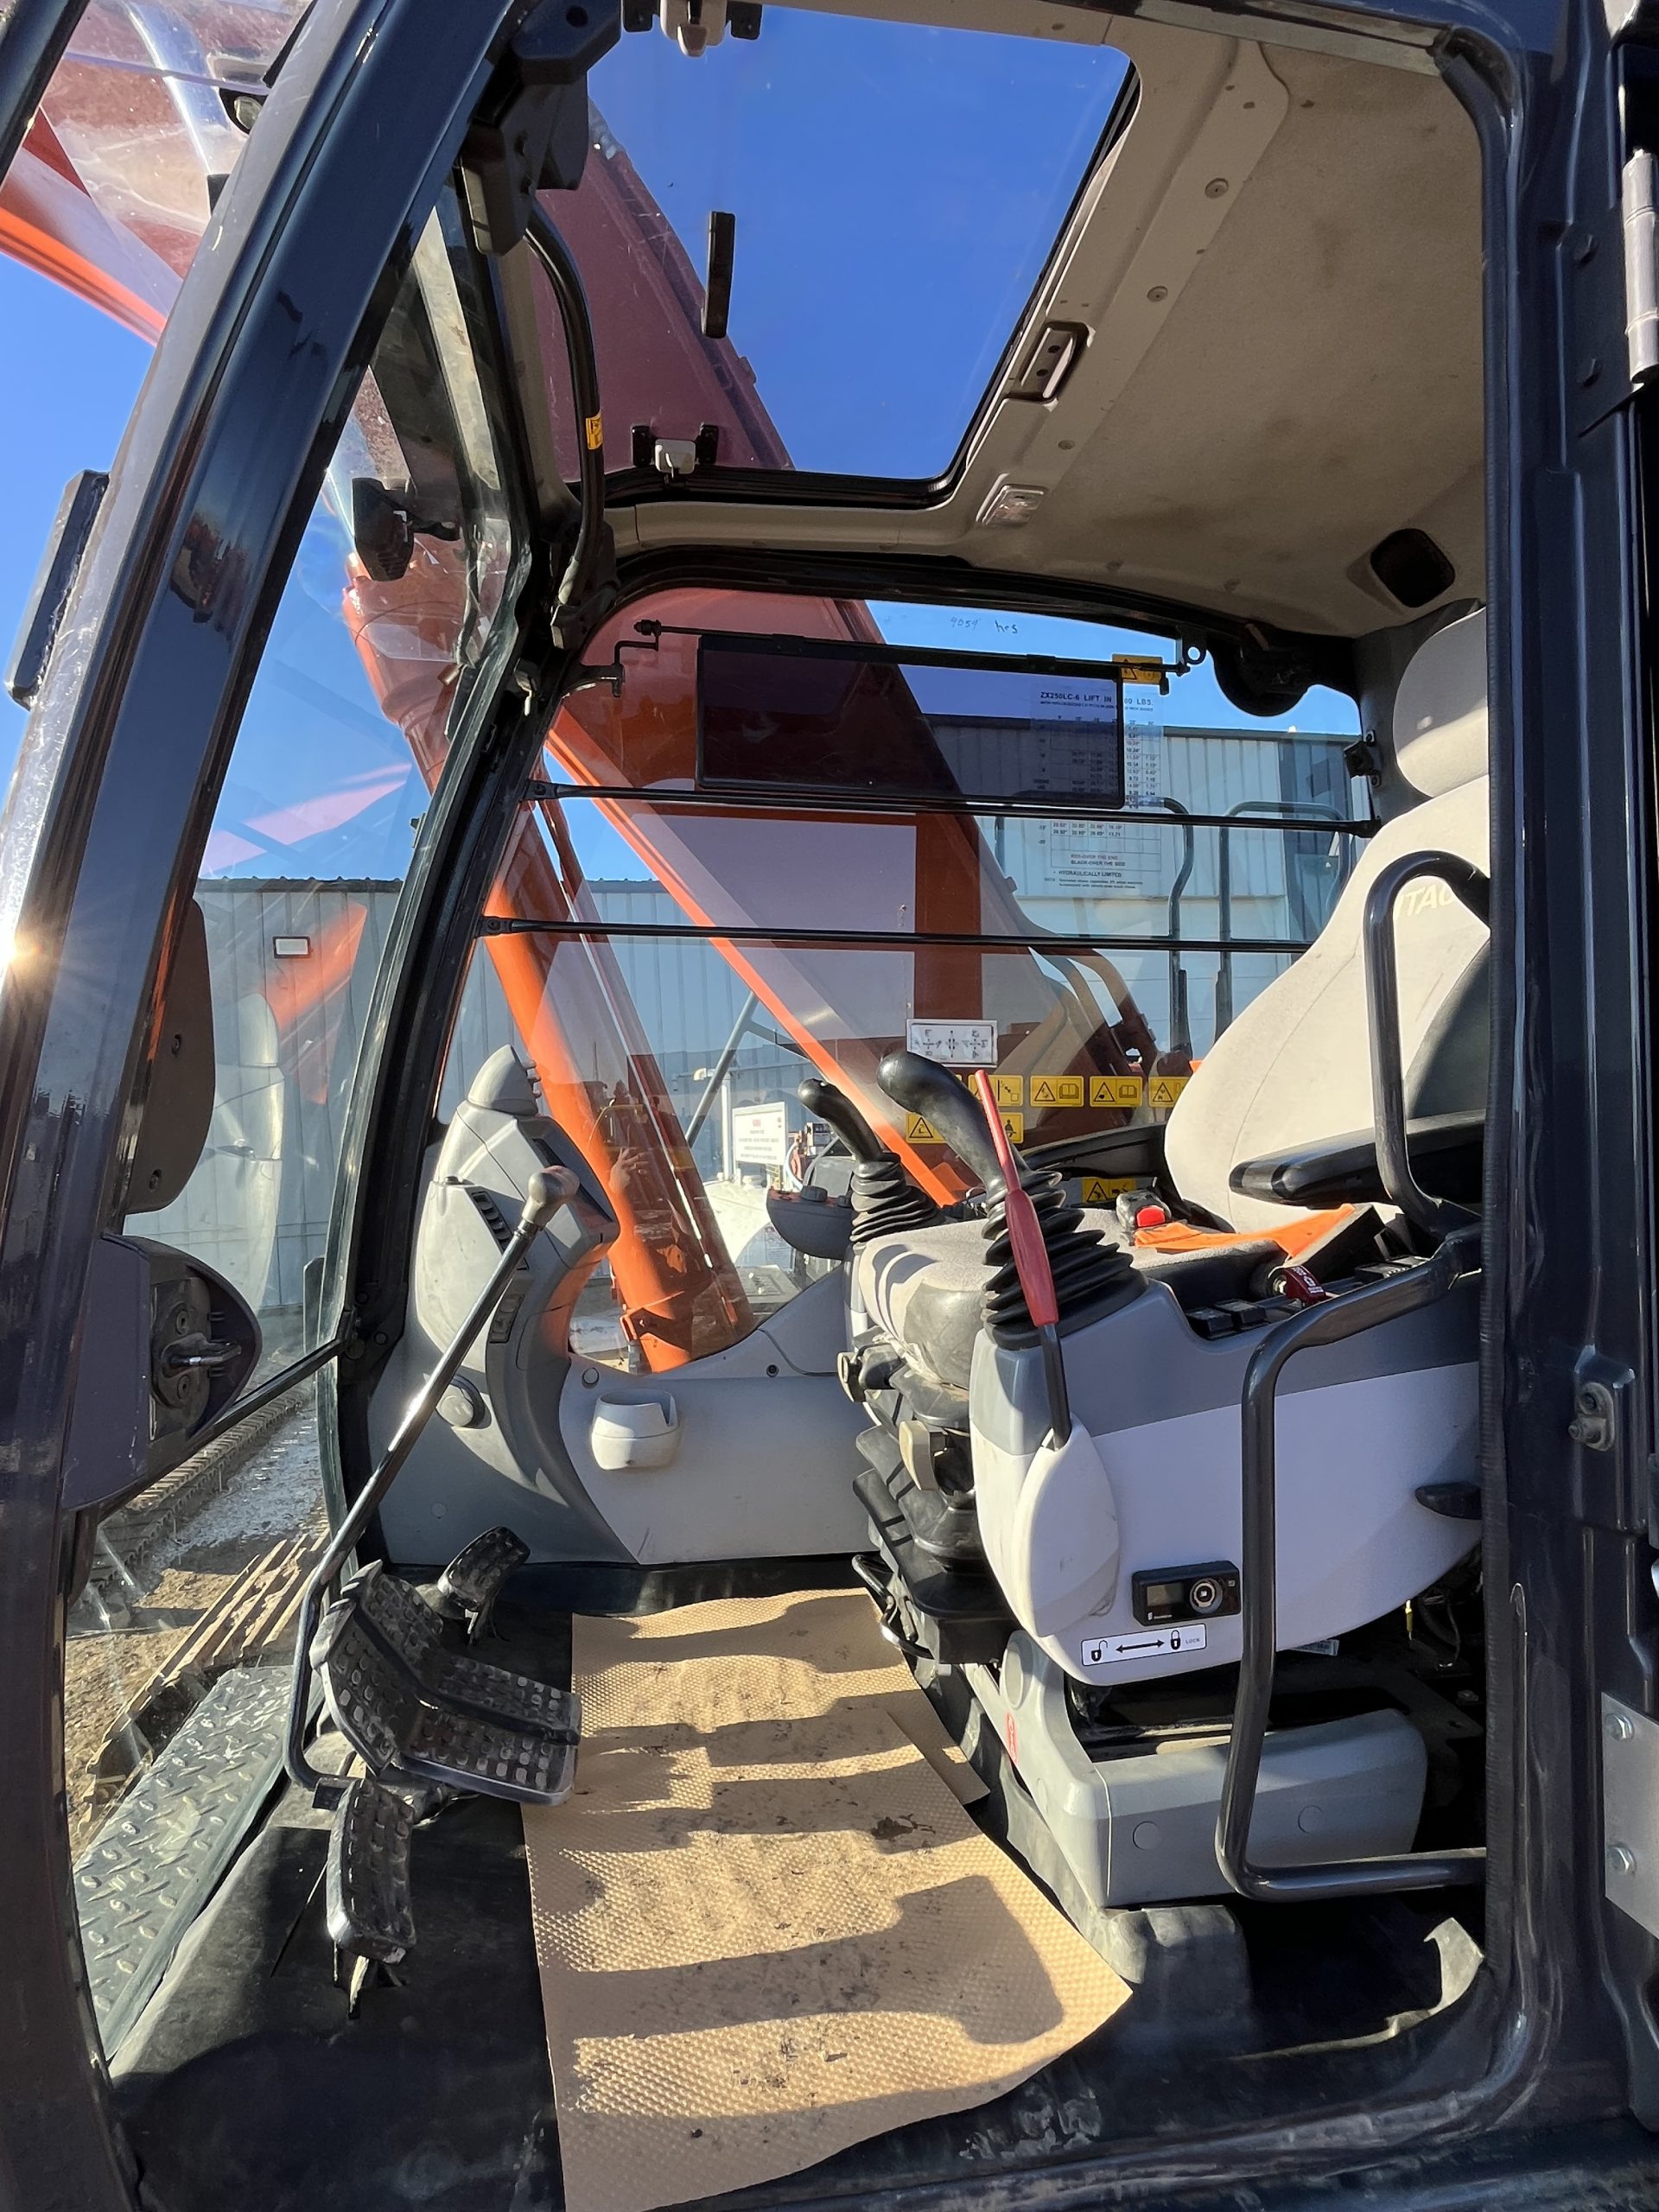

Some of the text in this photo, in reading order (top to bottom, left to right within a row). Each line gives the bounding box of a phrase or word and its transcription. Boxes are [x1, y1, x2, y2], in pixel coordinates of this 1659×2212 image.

[995, 620, 1018, 634] hrs
[1040, 691, 1080, 701] ZX250LC-6
[1393, 884, 1454, 920] ITAC
